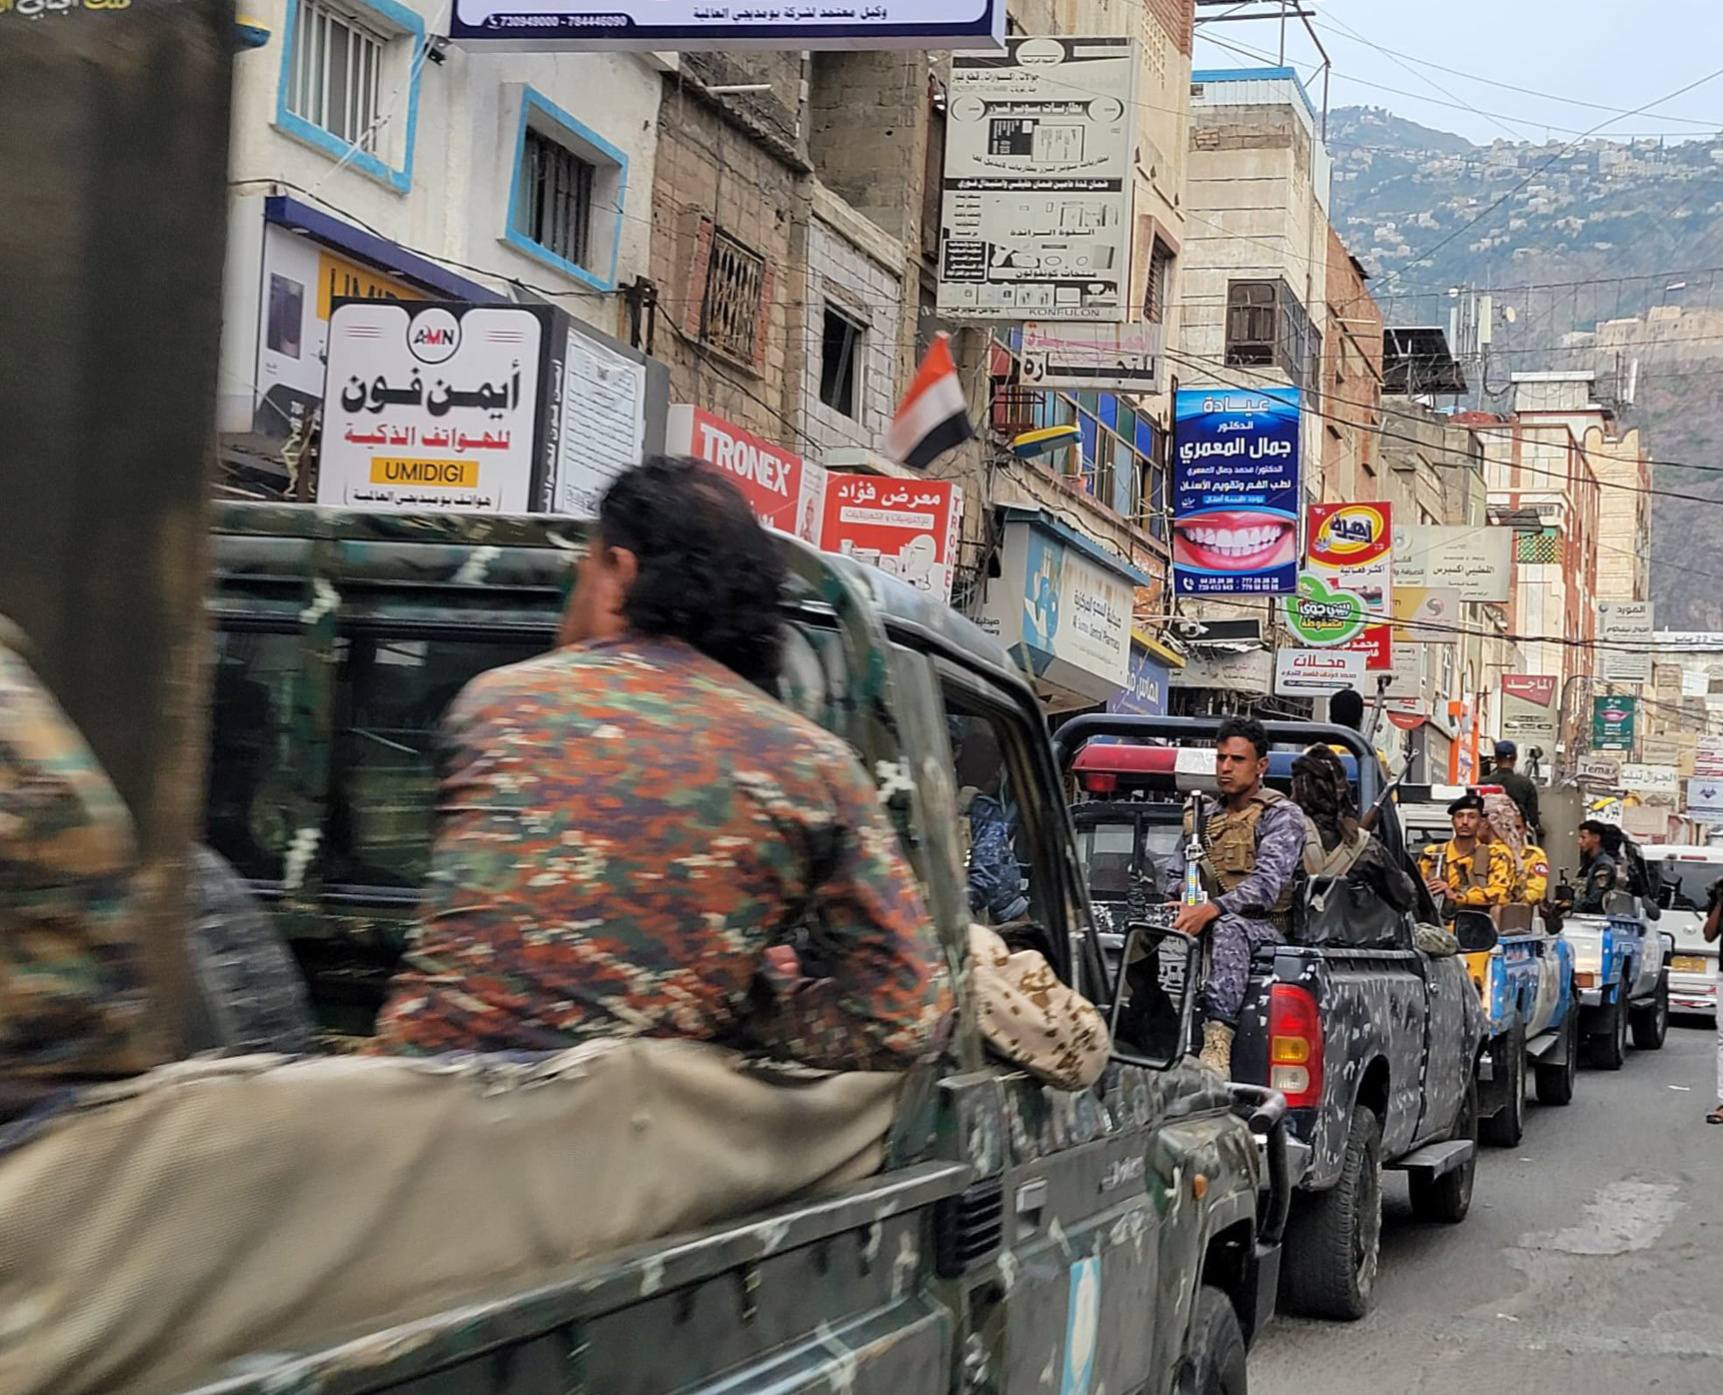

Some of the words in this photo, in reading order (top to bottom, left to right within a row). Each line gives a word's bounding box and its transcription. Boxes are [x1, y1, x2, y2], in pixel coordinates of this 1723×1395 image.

[819, 7, 855, 18] معتمد
[860, 6, 887, 20] وكيل
[341, 366, 424, 414] فون
[427, 358, 520, 419] أيمن
[1202, 396, 1270, 417] عيادة
[344, 422, 416, 449] الذكية
[1217, 421, 1254, 433] الدكتور
[421, 427, 511, 453] للهواتف
[1179, 437, 1245, 464] المعمري
[1249, 437, 1292, 459] جمال
[700, 422, 792, 498] TRONEX
[384, 462, 465, 483] UMIDIGI
[838, 481, 877, 504] فؤاد
[881, 486, 941, 508] معرض
[1294, 654, 1346, 669] محلات
[1506, 678, 1553, 694] الماجد
